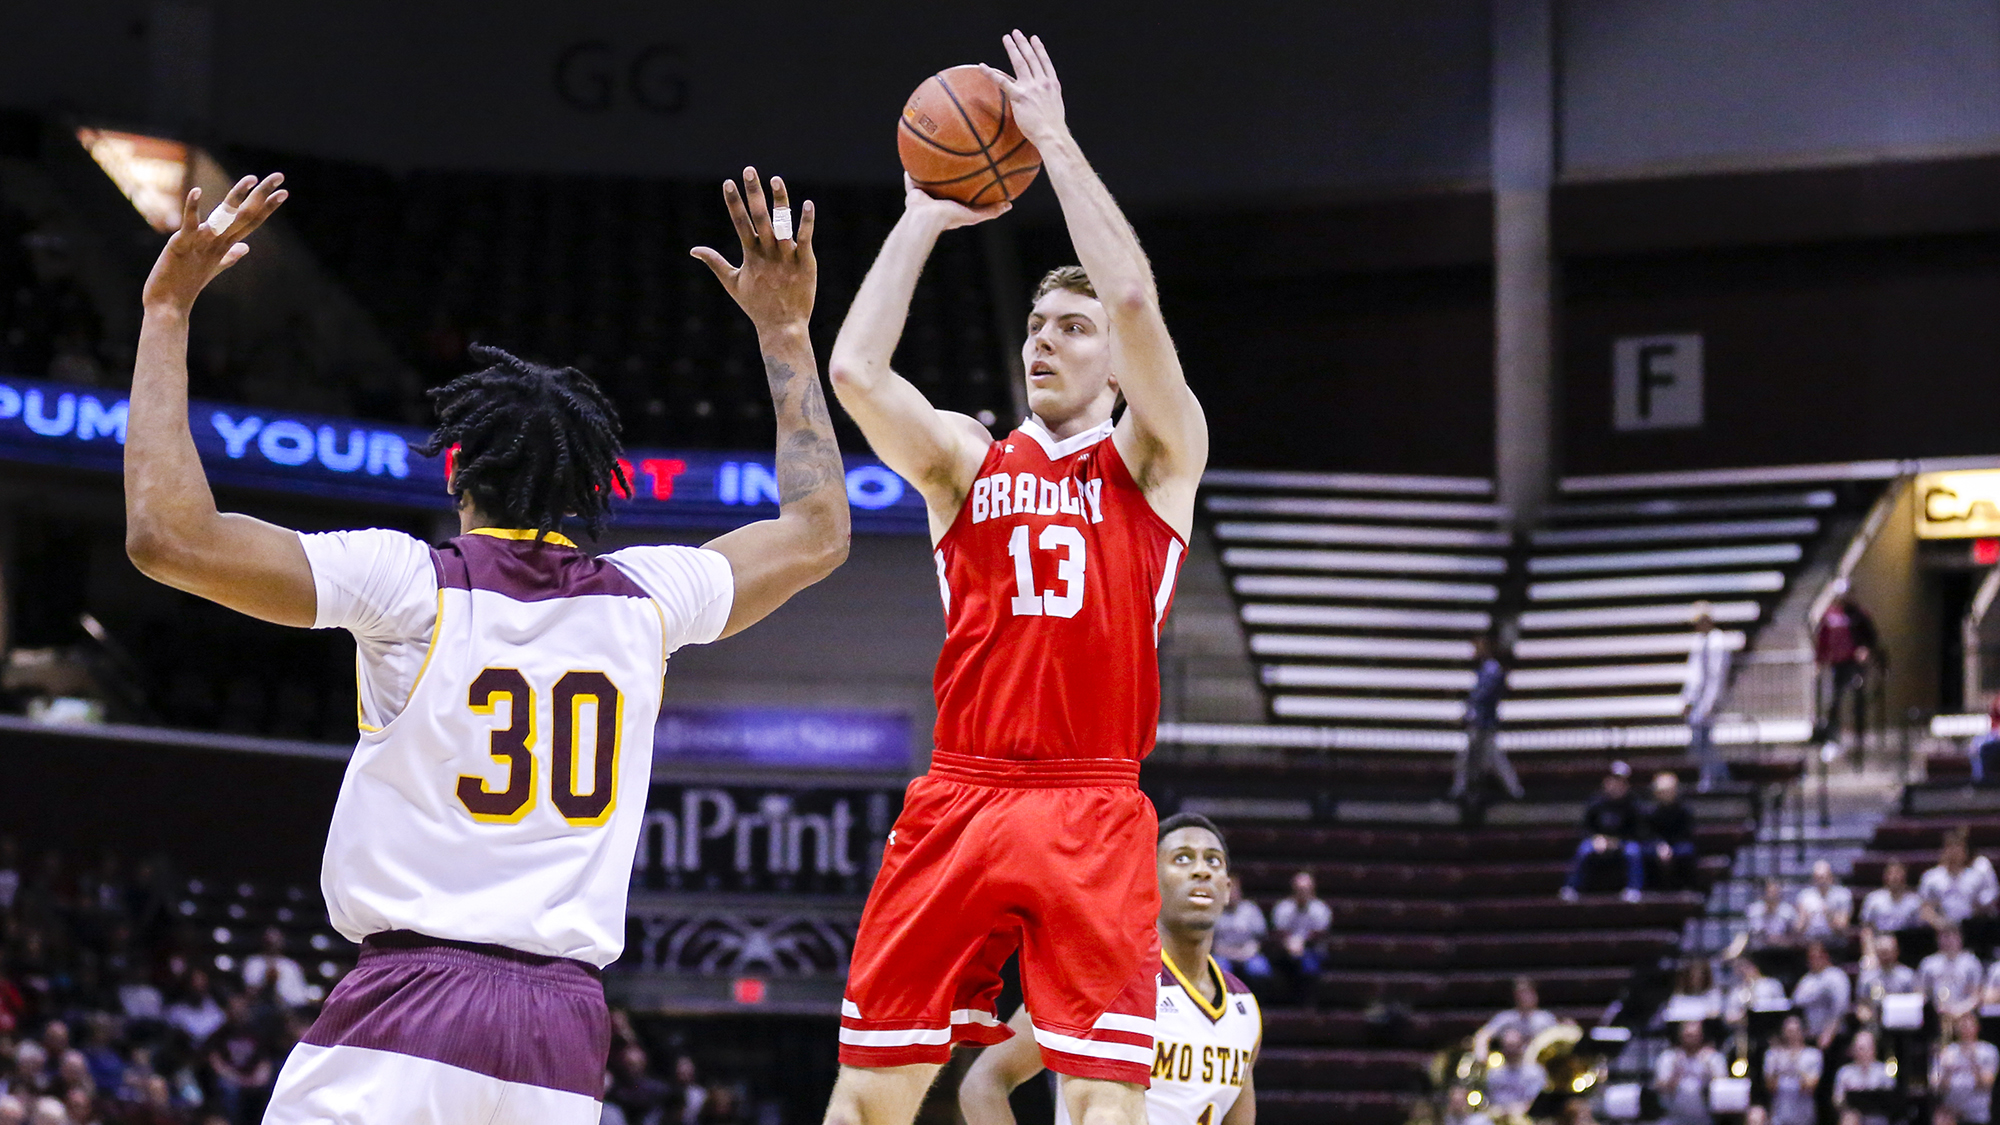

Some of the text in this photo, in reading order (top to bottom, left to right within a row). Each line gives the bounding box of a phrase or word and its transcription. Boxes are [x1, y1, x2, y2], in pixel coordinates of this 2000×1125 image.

[552, 39, 690, 115] GG
[1638, 344, 1677, 419] F
[211, 411, 410, 479] YOUR
[1008, 524, 1087, 619] 13
[455, 665, 625, 828] 30
[1151, 1041, 1193, 1083] MO
